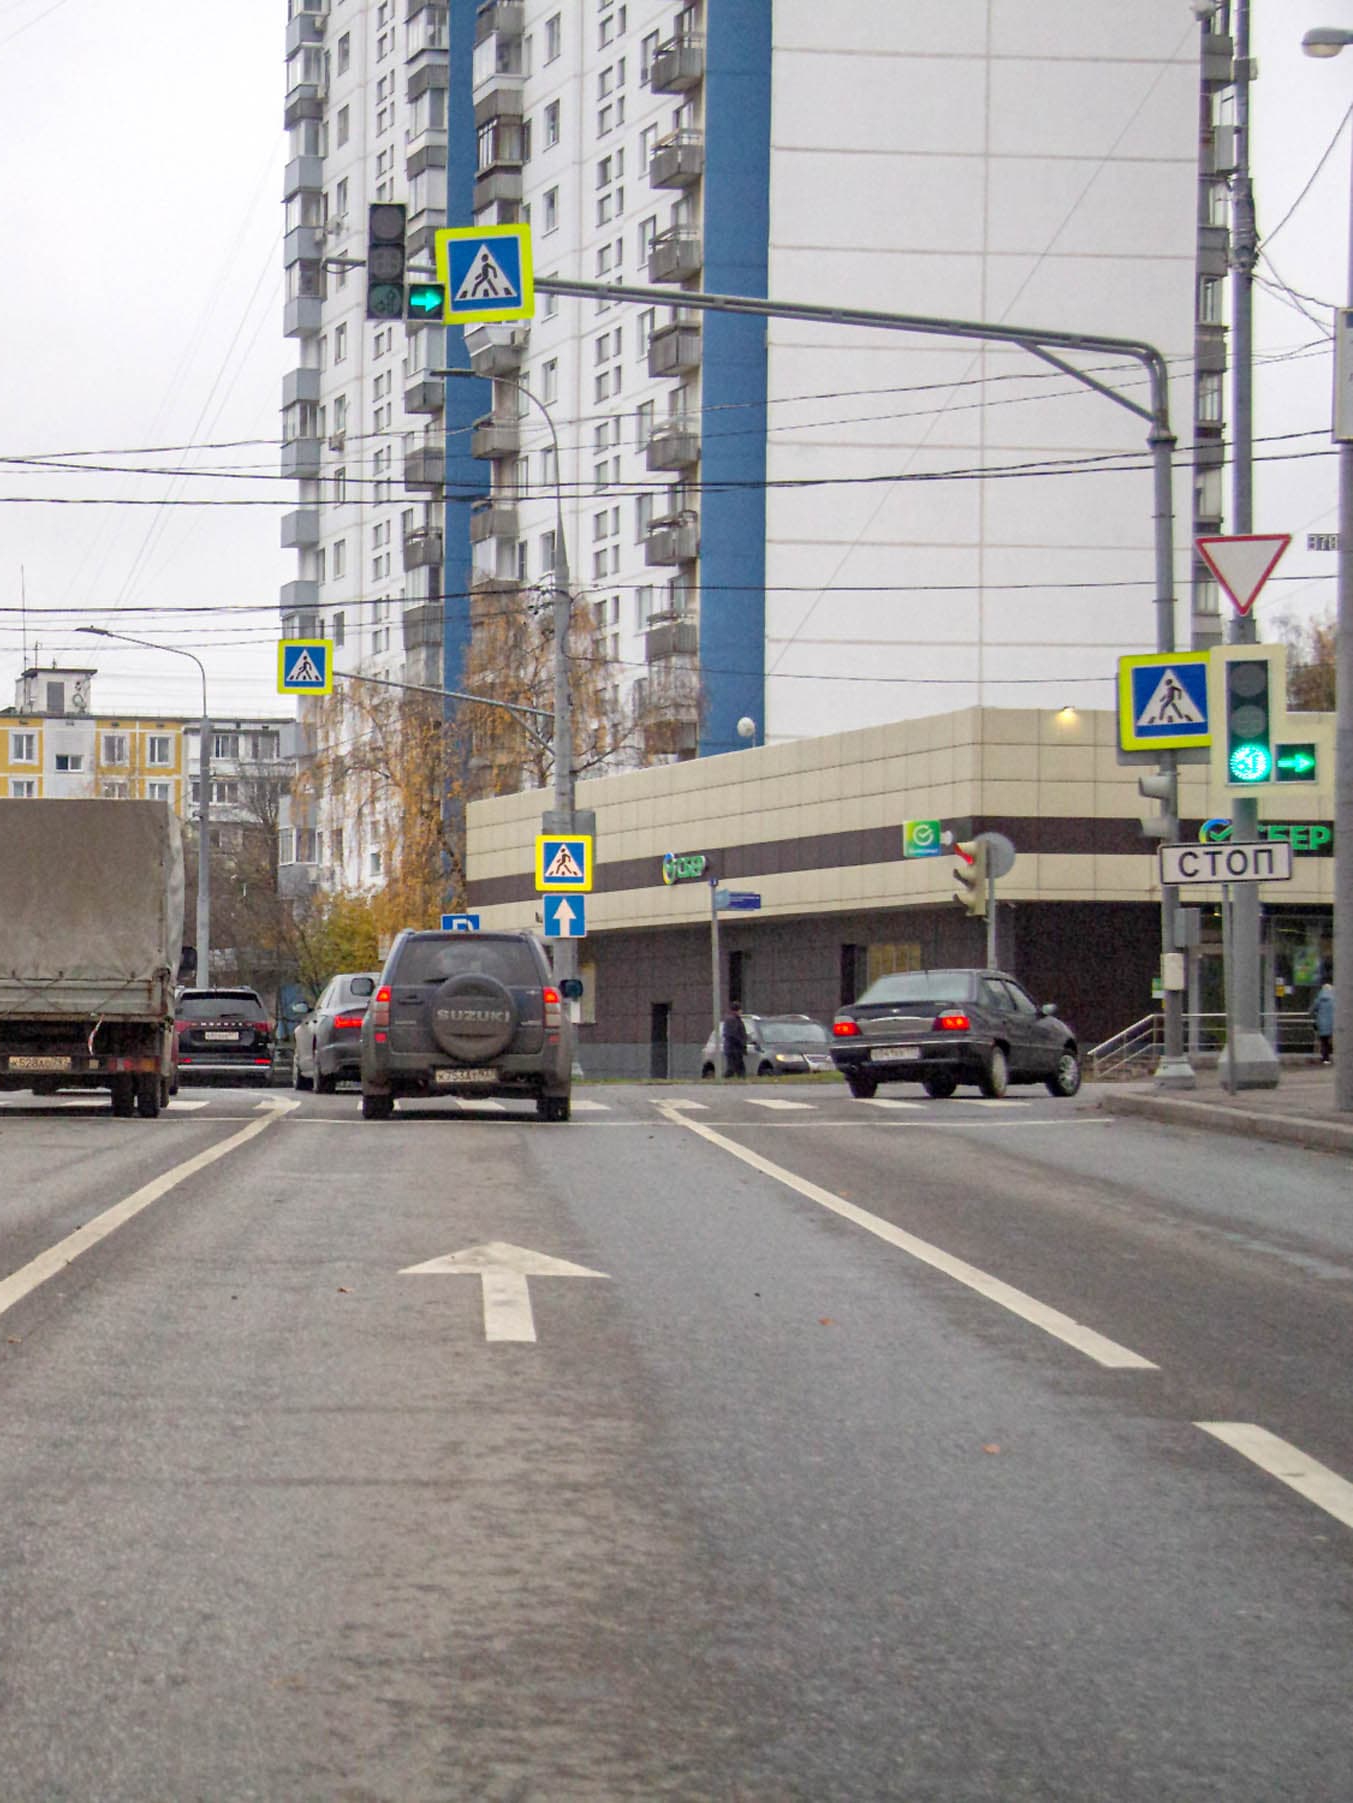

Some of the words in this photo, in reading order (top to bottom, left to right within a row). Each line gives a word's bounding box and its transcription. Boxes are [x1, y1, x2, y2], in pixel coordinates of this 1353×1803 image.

[1257, 825, 1331, 850] БЕР
[1178, 849, 1273, 877] СТОП
[436, 1009, 511, 1022] SUZUKI
